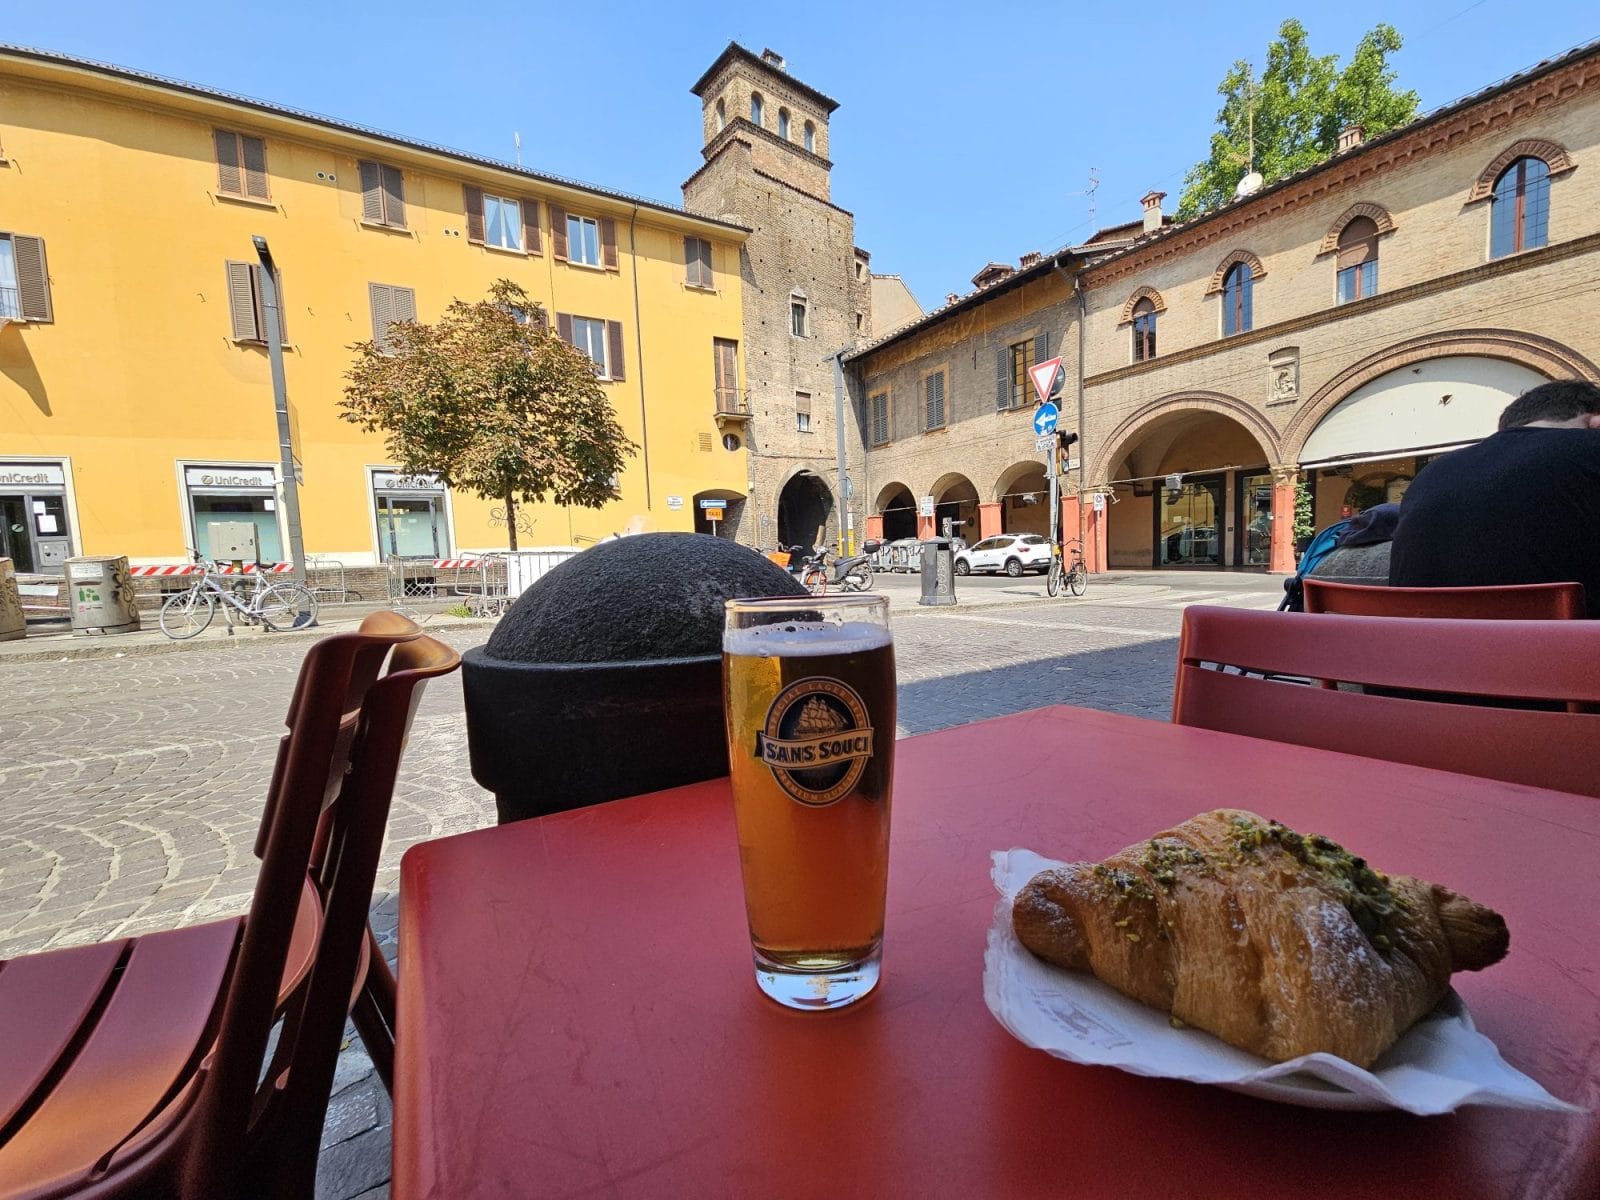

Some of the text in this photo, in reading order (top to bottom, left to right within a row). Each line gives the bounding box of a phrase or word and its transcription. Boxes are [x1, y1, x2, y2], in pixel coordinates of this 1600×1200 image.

[0, 472, 49, 483] niCredit
[214, 475, 263, 486] UniCredit
[808, 683, 847, 697] LAGER
[766, 737, 868, 762] SANS SOUCI
